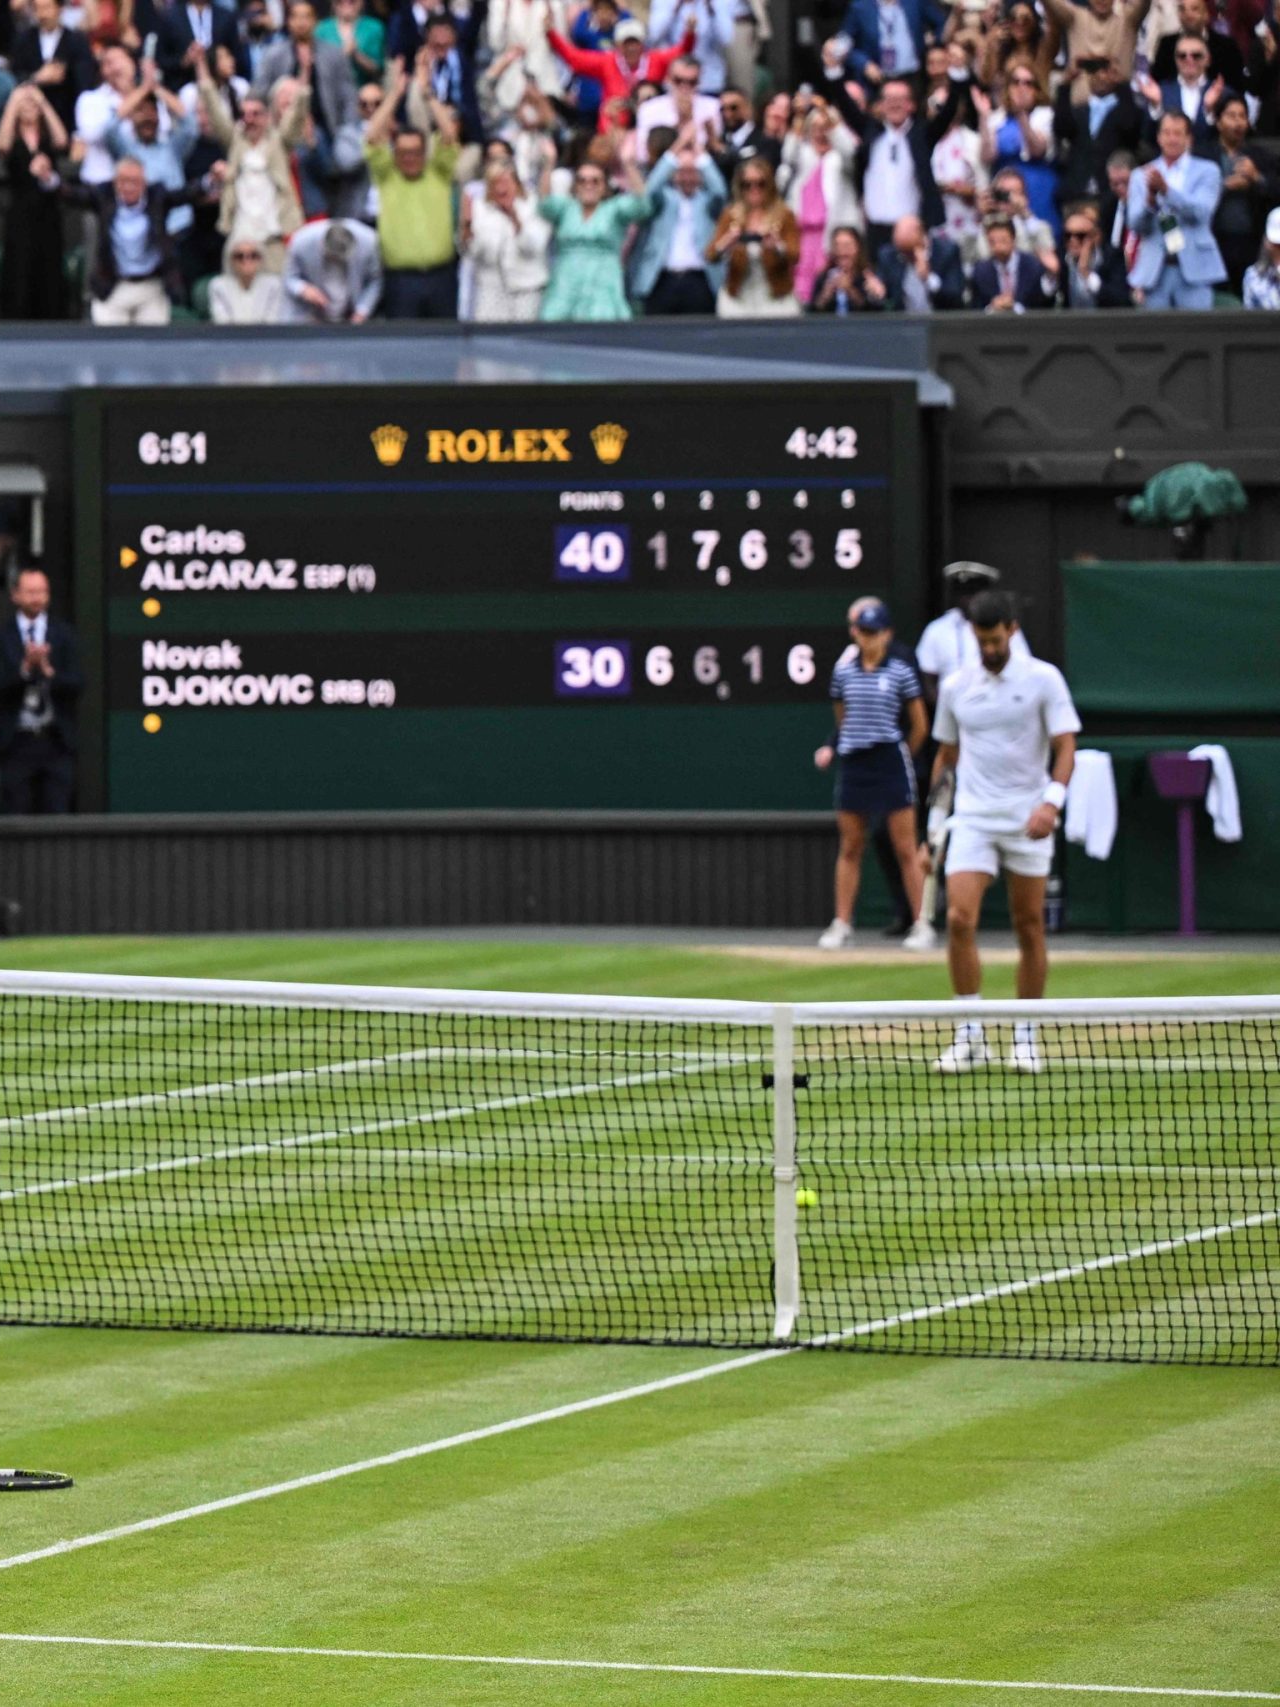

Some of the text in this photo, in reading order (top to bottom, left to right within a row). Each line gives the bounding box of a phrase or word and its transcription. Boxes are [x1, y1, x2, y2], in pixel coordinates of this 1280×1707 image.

[138, 431, 207, 465] 6:51
[427, 428, 572, 463] ROLEX
[784, 425, 858, 459] 4:42
[559, 490, 625, 512] POINTS
[140, 524, 246, 555] Carlos
[559, 530, 625, 573] 40
[648, 531, 667, 571] 1
[692, 529, 720, 571] 7
[739, 529, 768, 571] 6
[788, 530, 814, 569] 3
[834, 528, 863, 570] 5
[140, 558, 377, 593] ALCARAZ ESP (1)
[141, 639, 243, 671] Novak
[561, 645, 626, 689] 30
[645, 645, 674, 686] 6
[693, 646, 721, 685] 6
[742, 645, 763, 684] 1
[786, 643, 816, 685] 6
[141, 673, 315, 707] DJOKOVIC
[320, 678, 366, 705] SRB
